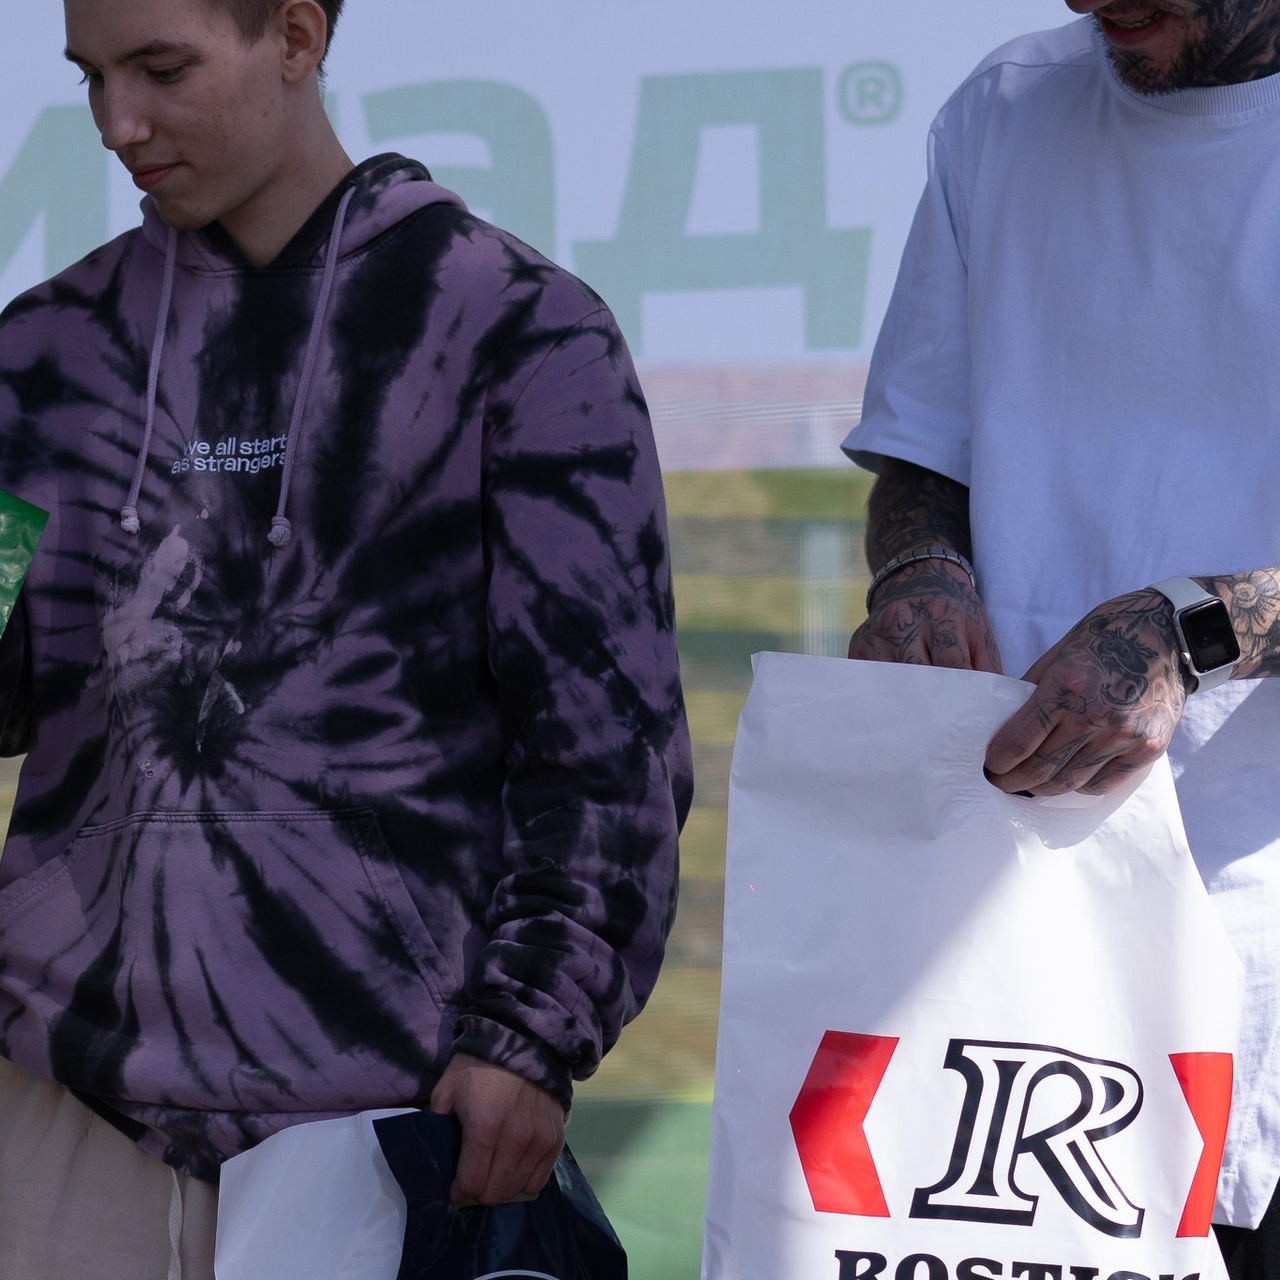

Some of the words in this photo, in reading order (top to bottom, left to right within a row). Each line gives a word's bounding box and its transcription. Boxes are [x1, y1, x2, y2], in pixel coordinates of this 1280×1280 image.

[215, 437, 236, 455] all
[171, 457, 190, 474] as
[908, 1037, 1146, 1239] R
